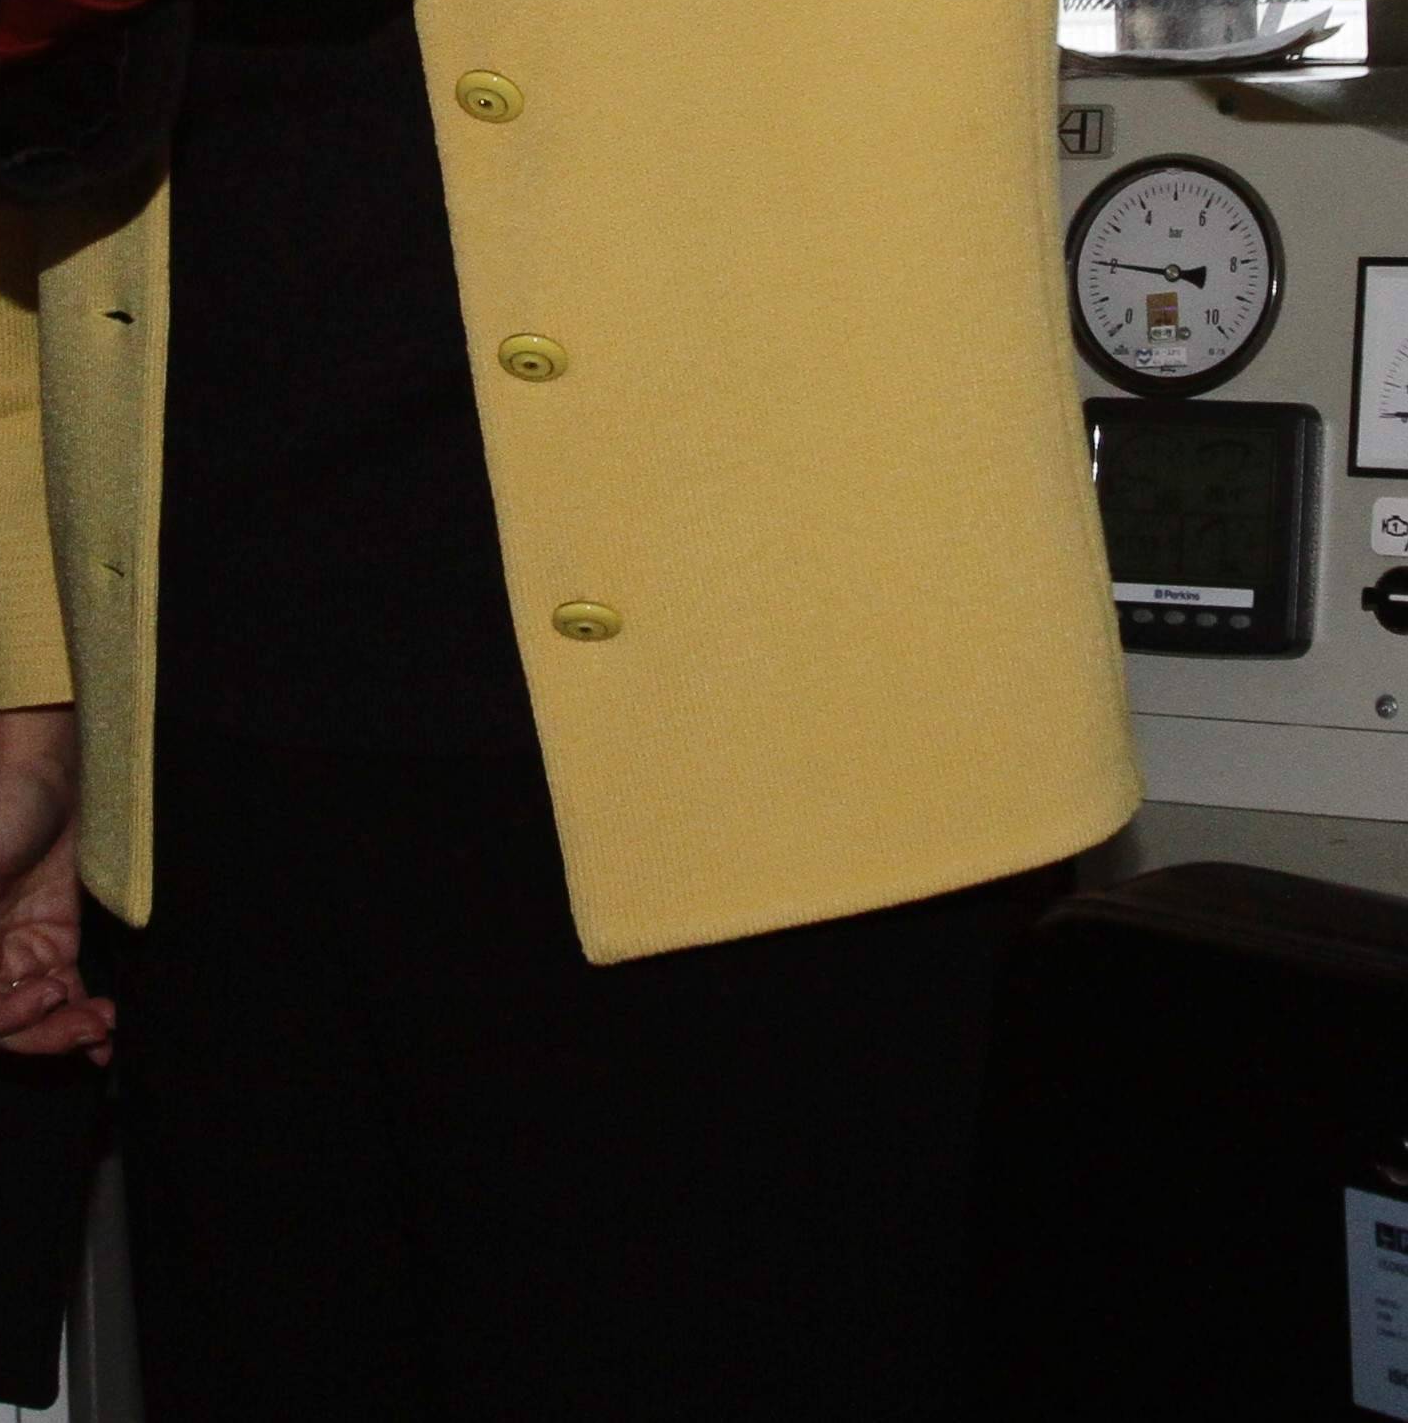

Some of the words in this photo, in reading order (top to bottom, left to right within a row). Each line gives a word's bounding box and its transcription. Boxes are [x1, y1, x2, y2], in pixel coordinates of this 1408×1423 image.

[1145, 210, 1152, 226] 4
[1199, 210, 1206, 227] 6
[1169, 228, 1183, 238] bar
[1230, 256, 1238, 273] 8
[1125, 308, 1133, 324] 0
[1205, 309, 1220, 326] 10
[1393, 523, 1399, 533] 1
[1164, 589, 1200, 601] Perkins
